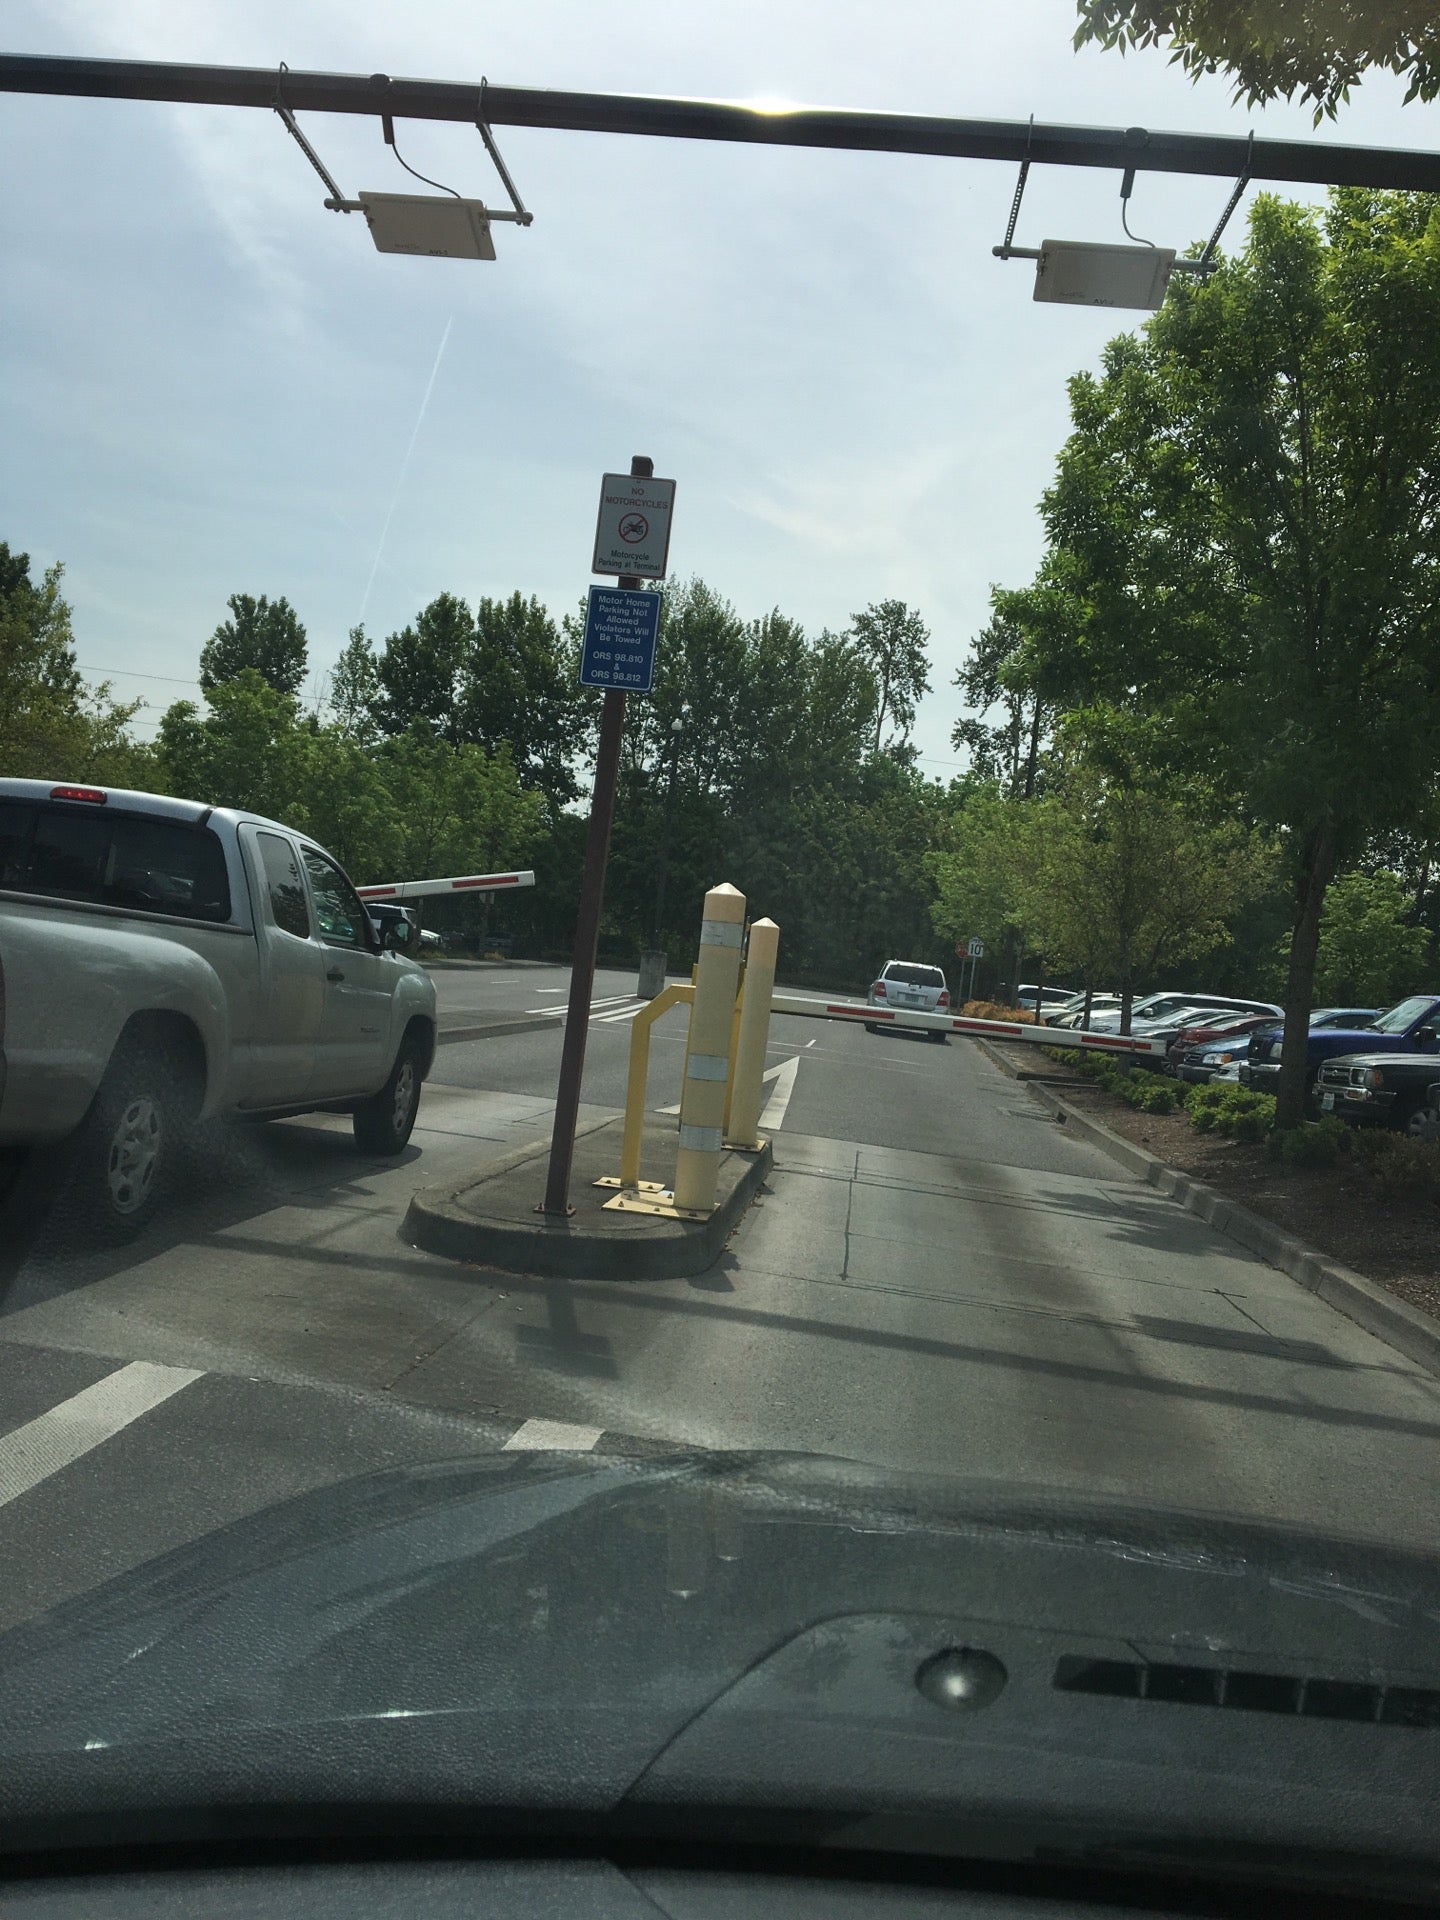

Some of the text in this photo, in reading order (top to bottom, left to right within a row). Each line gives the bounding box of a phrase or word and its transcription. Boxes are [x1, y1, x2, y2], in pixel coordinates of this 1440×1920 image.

[631, 487, 645, 496] NO
[605, 496, 669, 509] MOTORCYCLES
[611, 549, 650, 561] Motorcycle
[598, 558, 622, 569] Parking
[633, 561, 660, 571] Terminal
[598, 595, 651, 608] Motor Home
[598, 605, 648, 617] Parking Not
[606, 615, 639, 625] Allowed
[594, 623, 649, 636] Violators Will
[600, 633, 641, 645] Be Towed
[592, 651, 643, 663] ORS 98.810
[591, 669, 641, 682] ORS 98.812
[970, 943, 981, 955] 10
